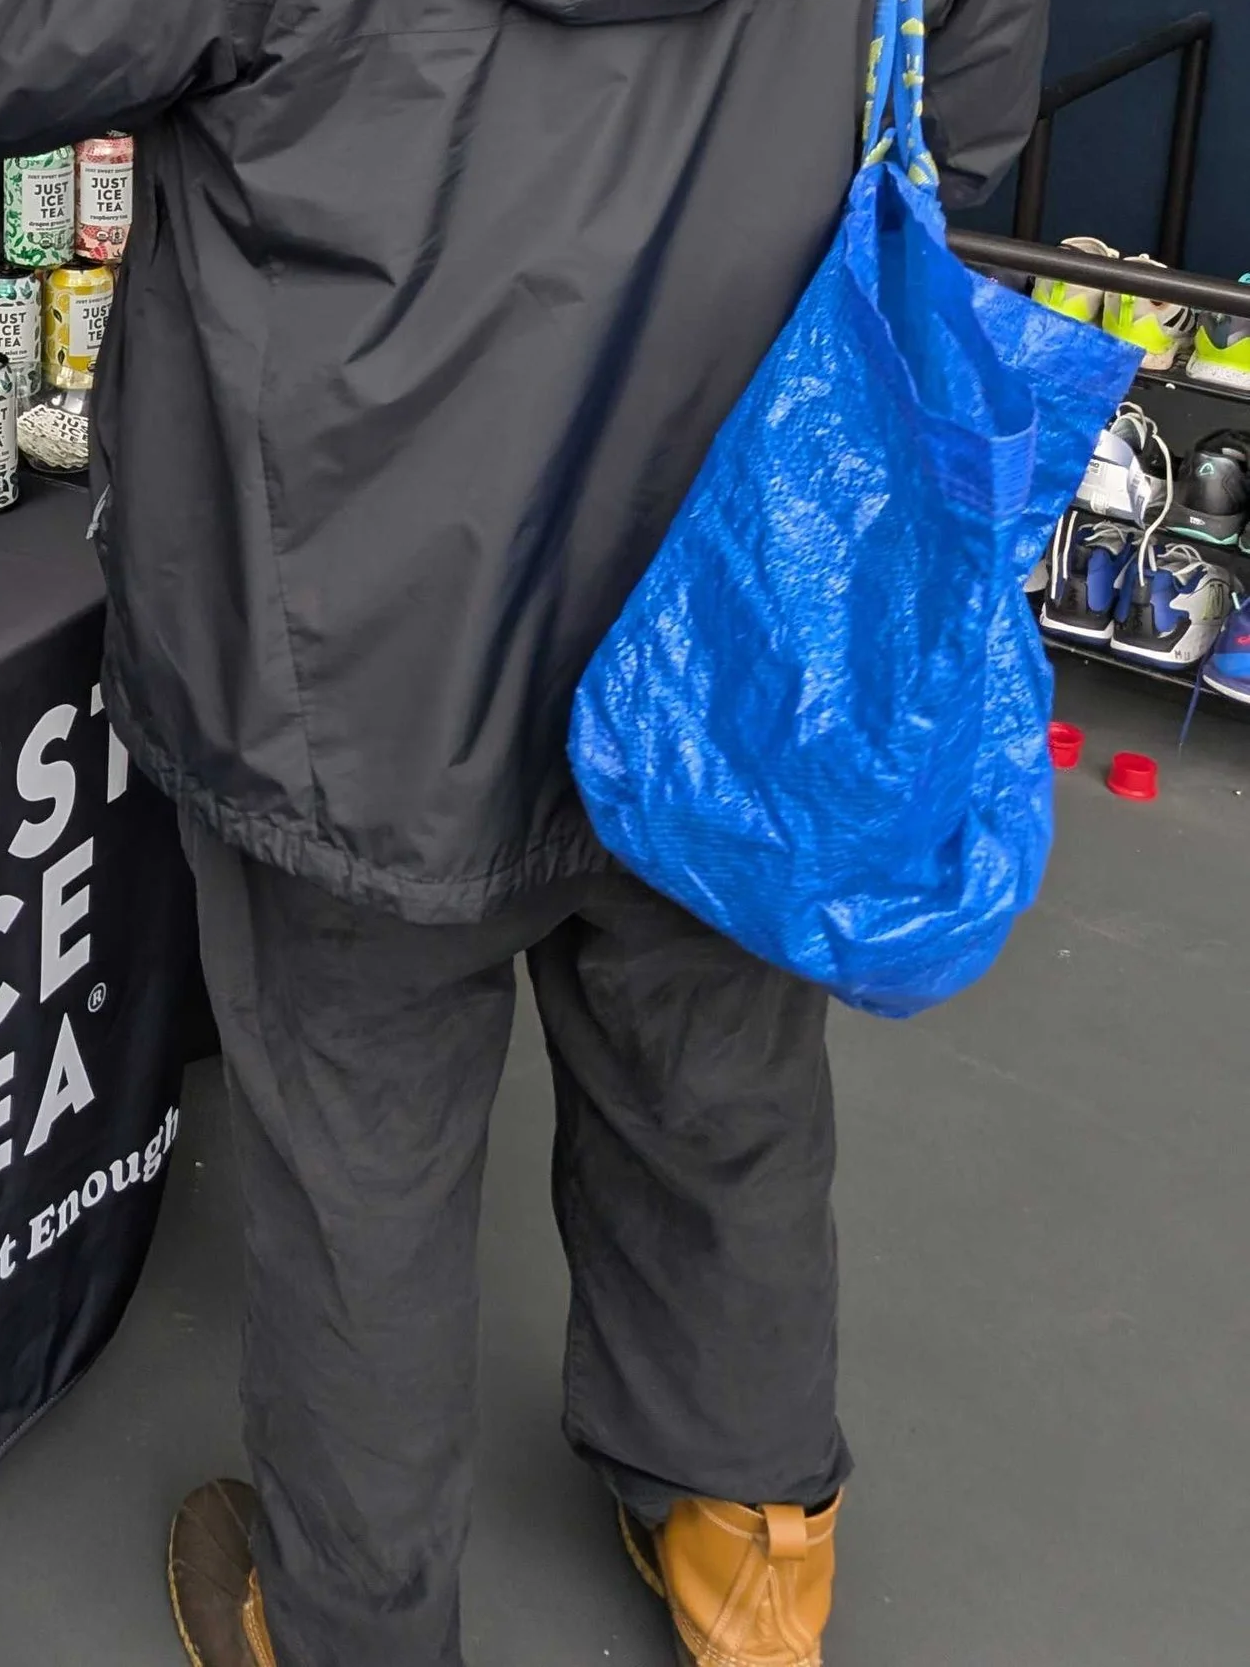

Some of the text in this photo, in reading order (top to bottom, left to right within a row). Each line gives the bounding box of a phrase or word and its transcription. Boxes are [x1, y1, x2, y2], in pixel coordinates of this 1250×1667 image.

[92, 177, 127, 188] JUST
[34, 182, 68, 195] JUST
[98, 190, 121, 200] ICE
[41, 194, 64, 207] ICE
[97, 202, 122, 212] TEA
[41, 208, 64, 218] TEA
[88, 331, 102, 341] TE
[28, 1105, 180, 1260] Enough
